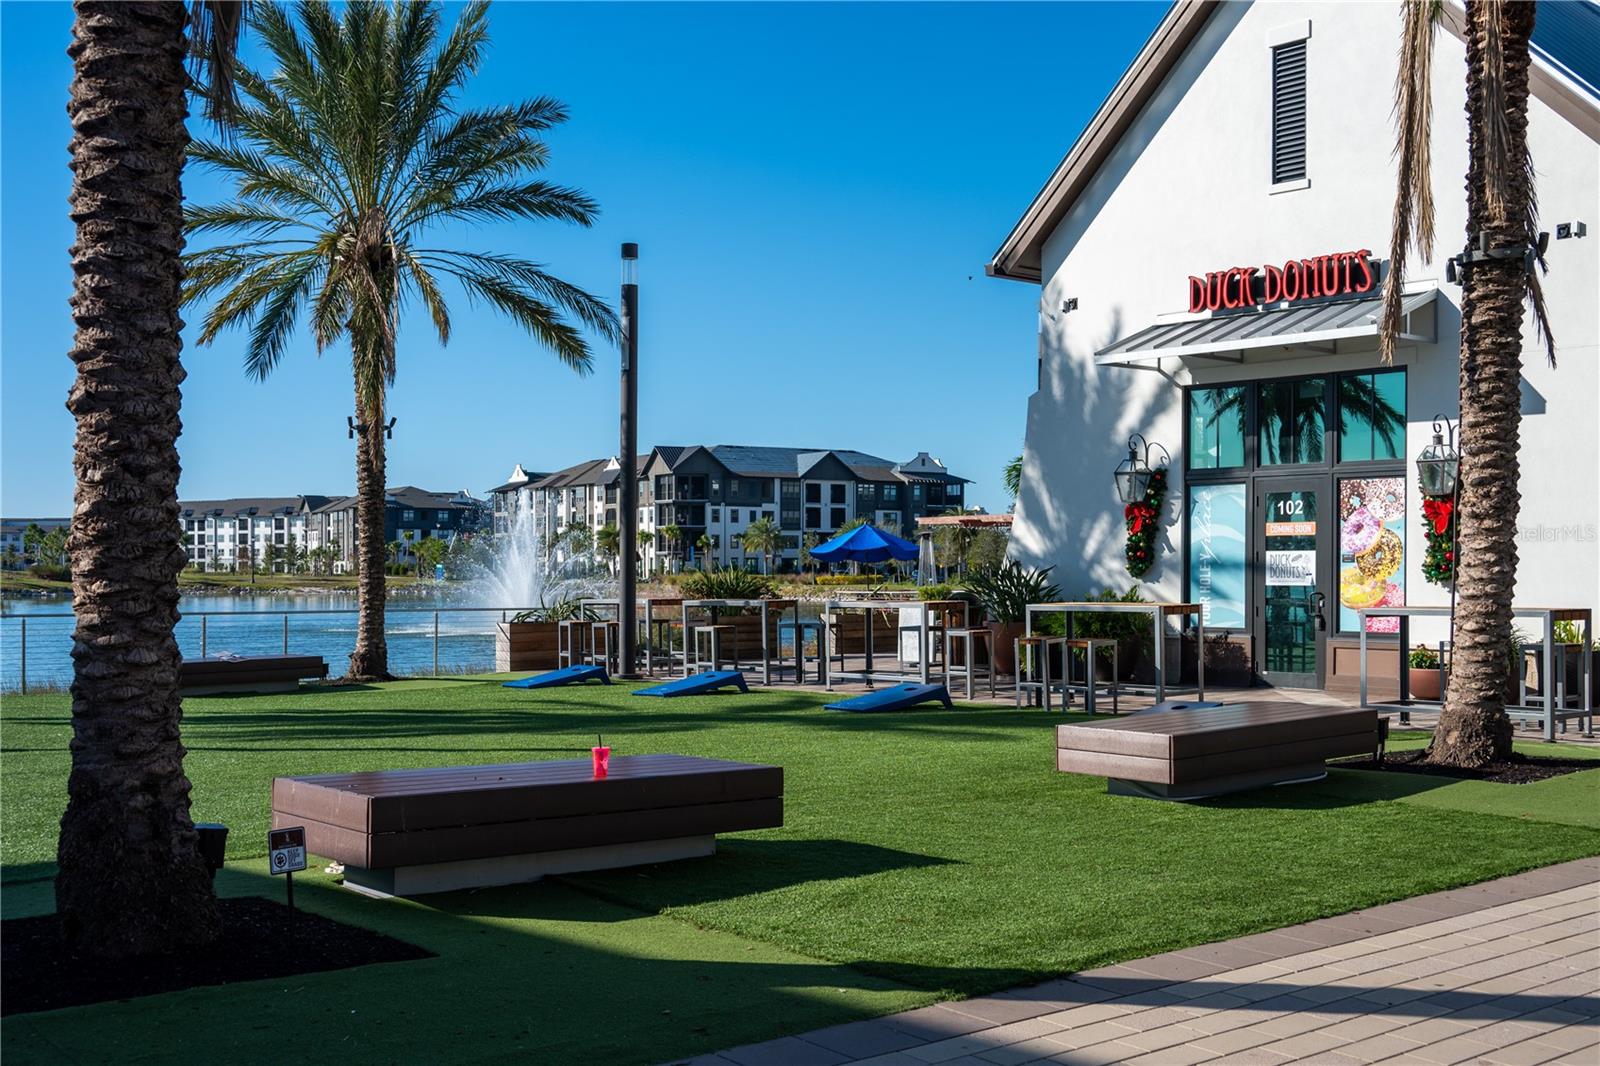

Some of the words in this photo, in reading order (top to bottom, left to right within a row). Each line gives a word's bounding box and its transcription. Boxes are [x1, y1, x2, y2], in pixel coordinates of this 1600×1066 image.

[1188, 267, 1259, 313] DUCK
[1264, 249, 1372, 304] DONUTS
[1277, 500, 1304, 515] 102
[1270, 524, 1294, 534] COMING
[1295, 524, 1312, 533] SOON
[1269, 553, 1291, 567] DUCK
[1200, 552, 1211, 593] HOLE-Y
[1269, 566, 1301, 578] DONUTS
[1200, 596, 1211, 626] YOUR
